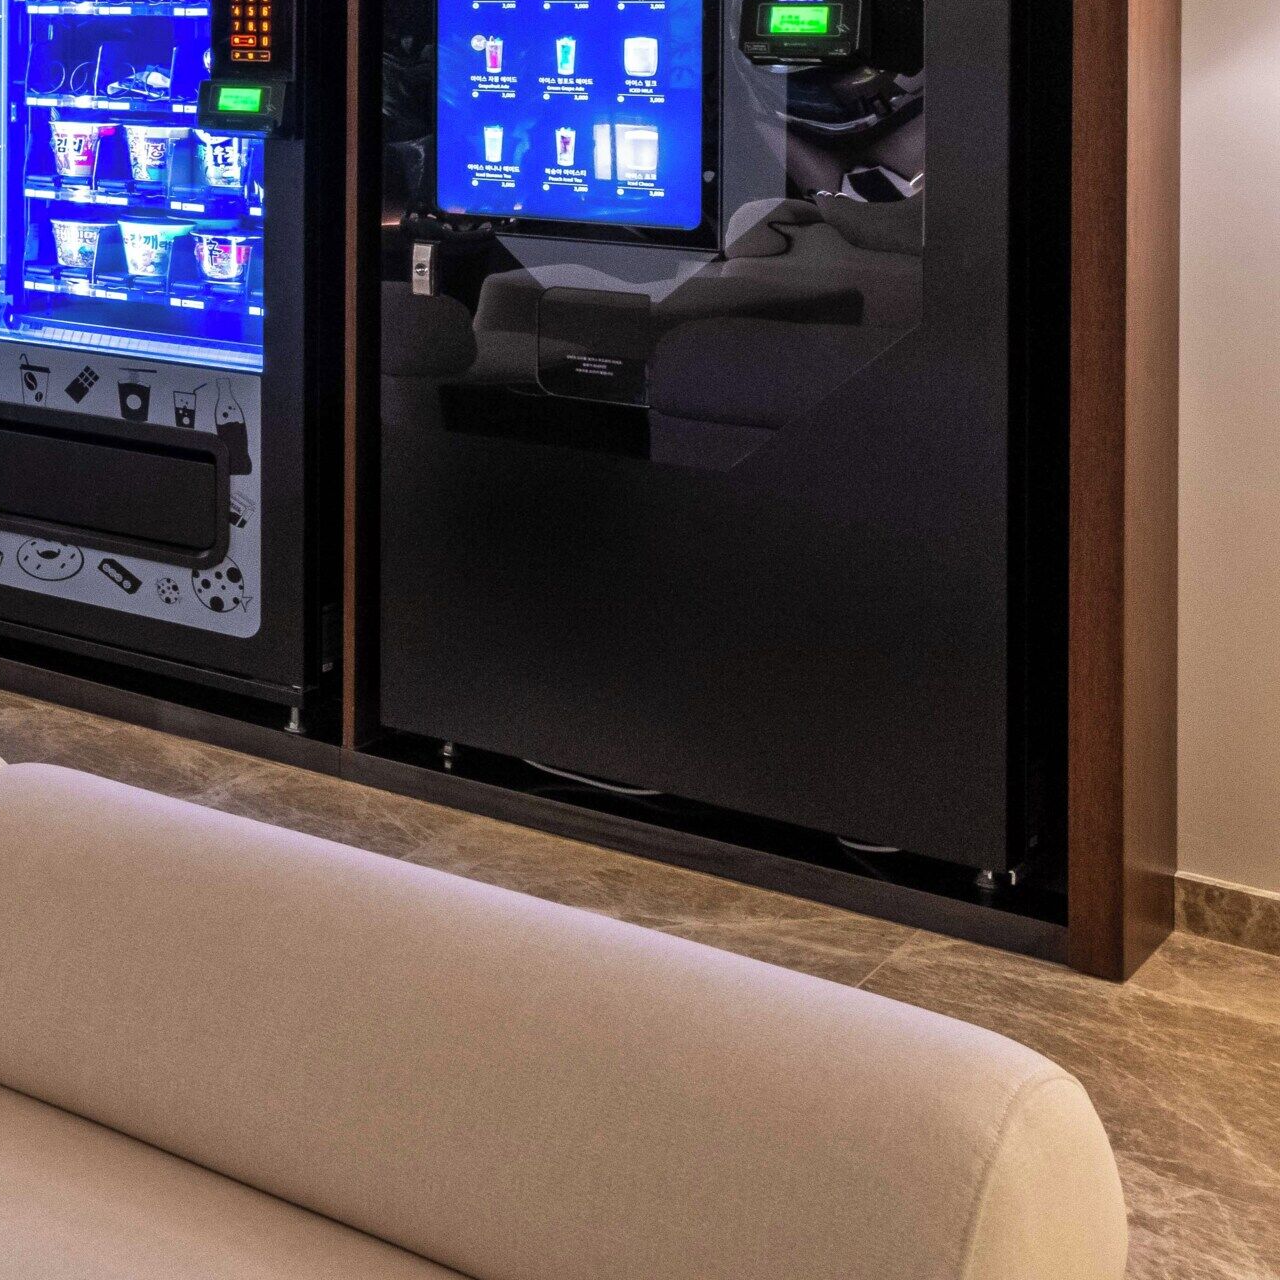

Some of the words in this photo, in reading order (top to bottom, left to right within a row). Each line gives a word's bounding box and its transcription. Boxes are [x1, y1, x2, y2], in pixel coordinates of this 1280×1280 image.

[234, 7, 240, 16] 4
[248, 7, 254, 16] 5
[262, 7, 268, 16] 6
[234, 22, 240, 31] 7
[248, 22, 254, 31] 8
[262, 22, 268, 31] 9
[262, 36, 268, 46] 0
